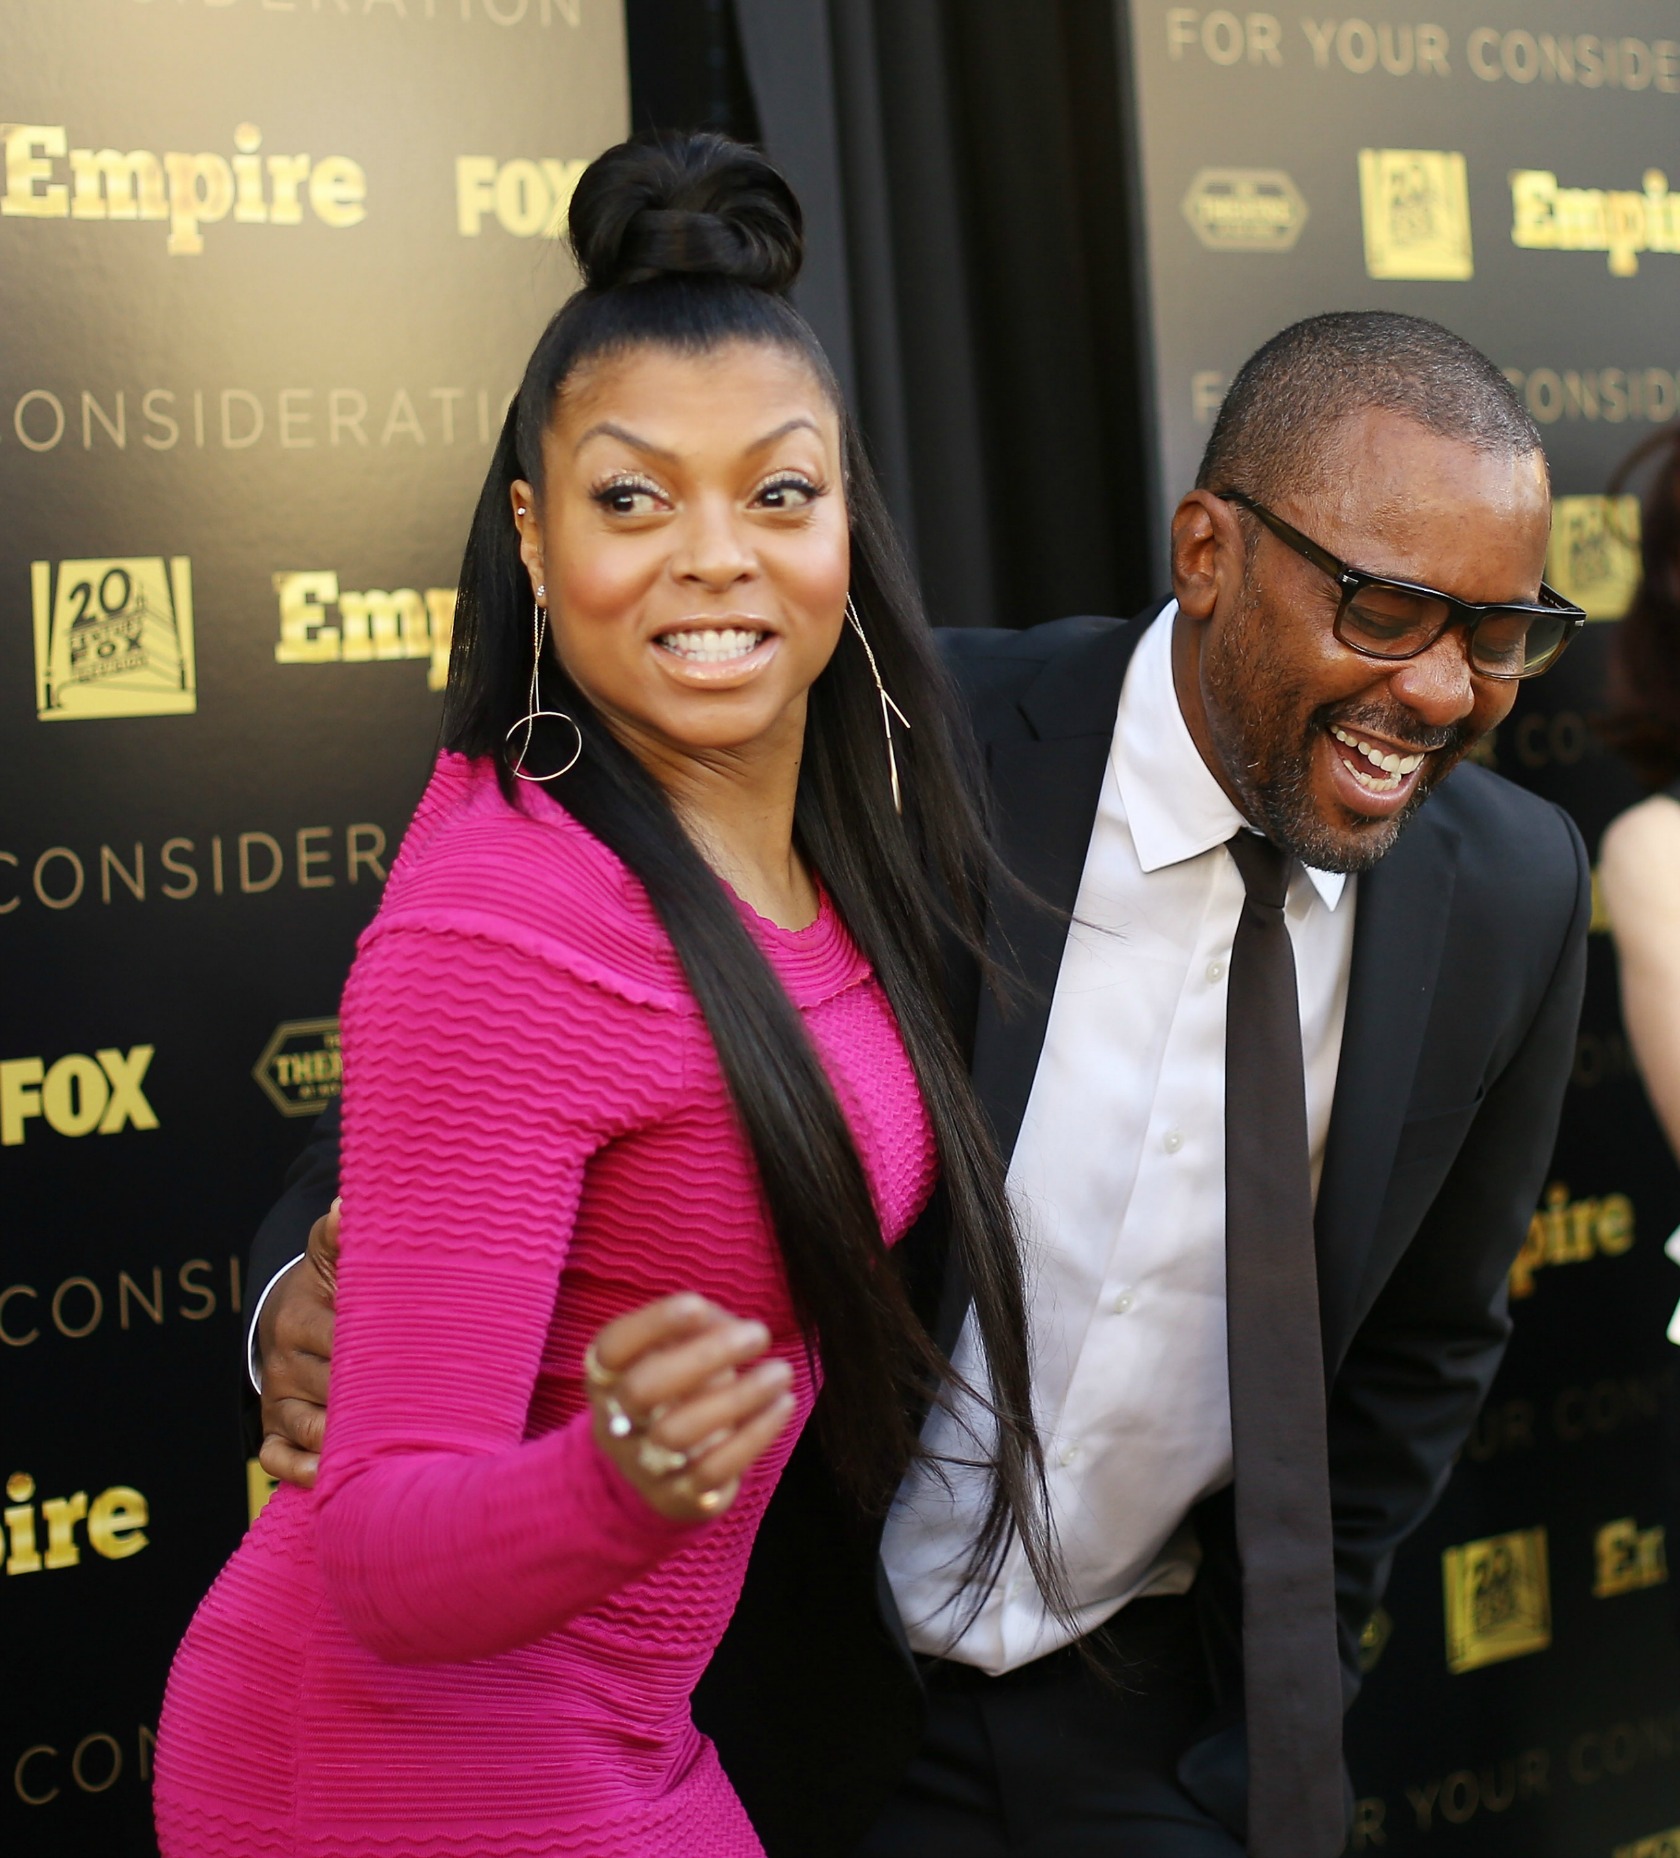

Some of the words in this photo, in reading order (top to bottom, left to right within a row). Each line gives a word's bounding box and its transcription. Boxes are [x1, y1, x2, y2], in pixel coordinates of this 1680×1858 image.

[1166, 9, 1284, 67] FOR
[1303, 18, 1452, 76] YOUR
[0, 122, 367, 256] Empire
[14, 387, 519, 452] ONSIDERATI
[69, 567, 132, 628] 20
[0, 1044, 160, 1146] FOX
[0, 1254, 241, 1346] CONSI
[0, 1470, 149, 1576] ire
